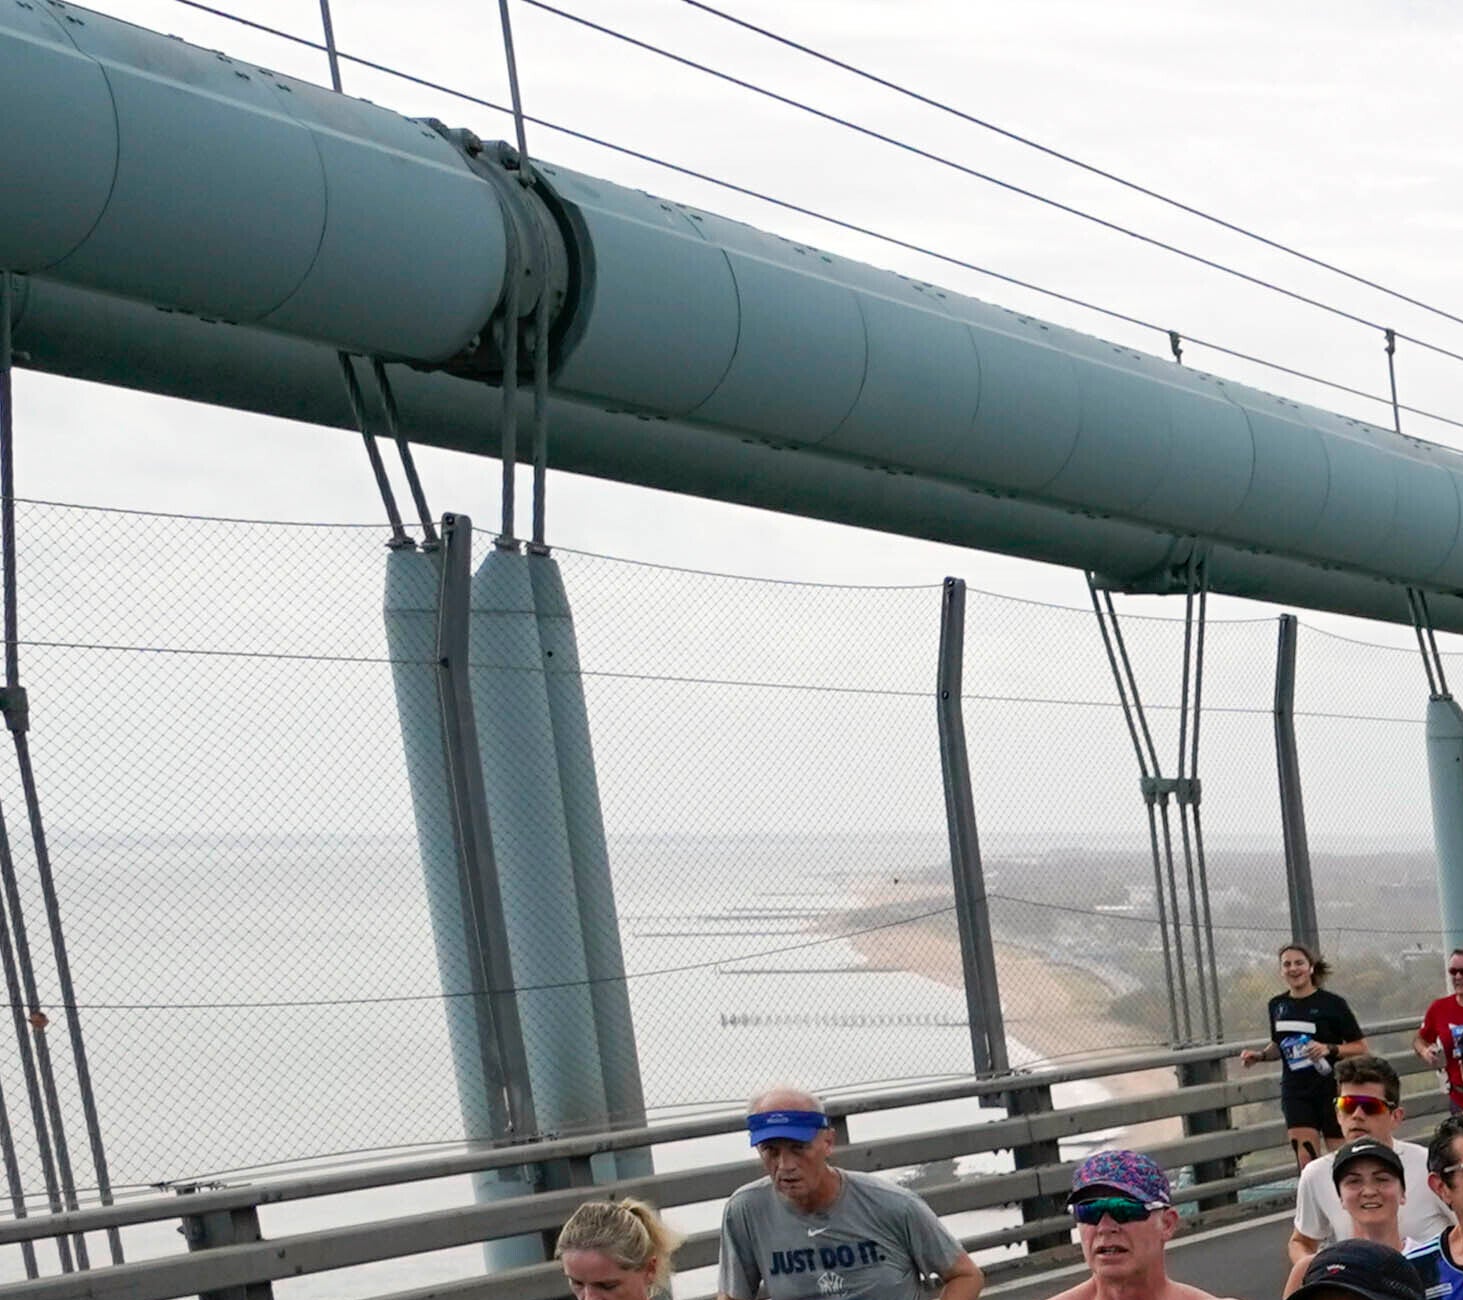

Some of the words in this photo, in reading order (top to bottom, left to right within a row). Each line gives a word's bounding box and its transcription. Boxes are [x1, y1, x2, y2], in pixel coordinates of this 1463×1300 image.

[771, 1249, 817, 1276] JUST
[820, 1244, 858, 1271] DO
[860, 1238, 888, 1266] IT.
